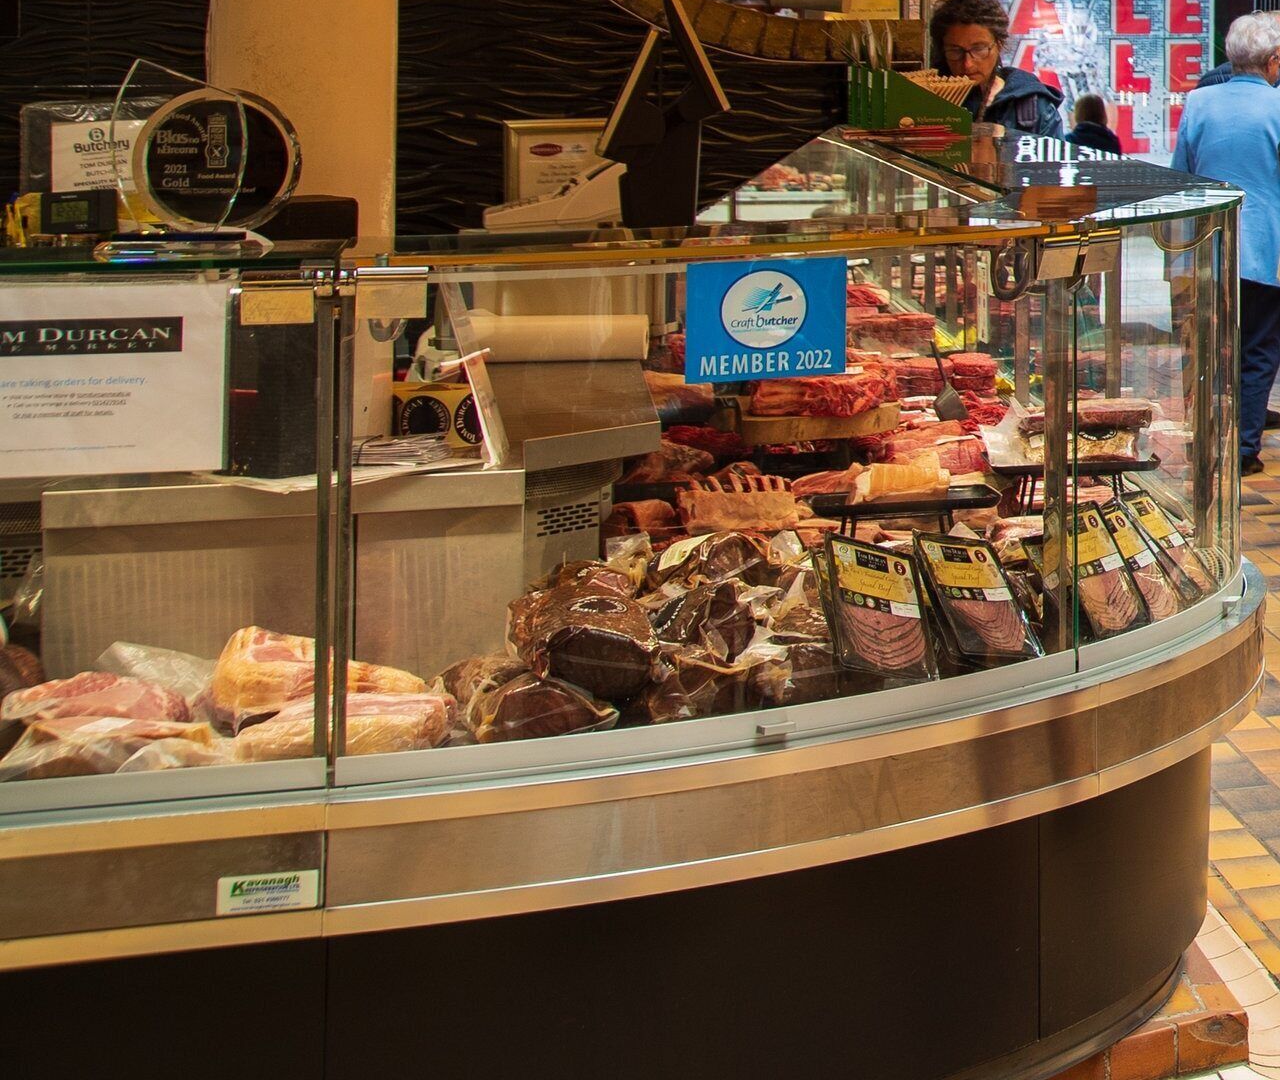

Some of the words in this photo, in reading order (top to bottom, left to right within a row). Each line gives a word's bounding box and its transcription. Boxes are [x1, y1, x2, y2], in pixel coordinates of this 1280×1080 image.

[1010, 38, 1202, 92] ALE
[156, 129, 188, 144] Blas
[164, 164, 187, 174] 2021
[162, 177, 190, 188] Gold
[731, 317, 755, 329] Craft
[756, 315, 798, 328] butcher
[38, 326, 172, 342] DURCAN
[700, 351, 789, 377] MEMBER
[796, 349, 832, 370] 2022
[0, 380, 17, 389] are
[20, 379, 51, 389] taking
[52, 377, 87, 386] orders
[88, 377, 102, 385] for
[230, 874, 300, 897] Kavanagh
